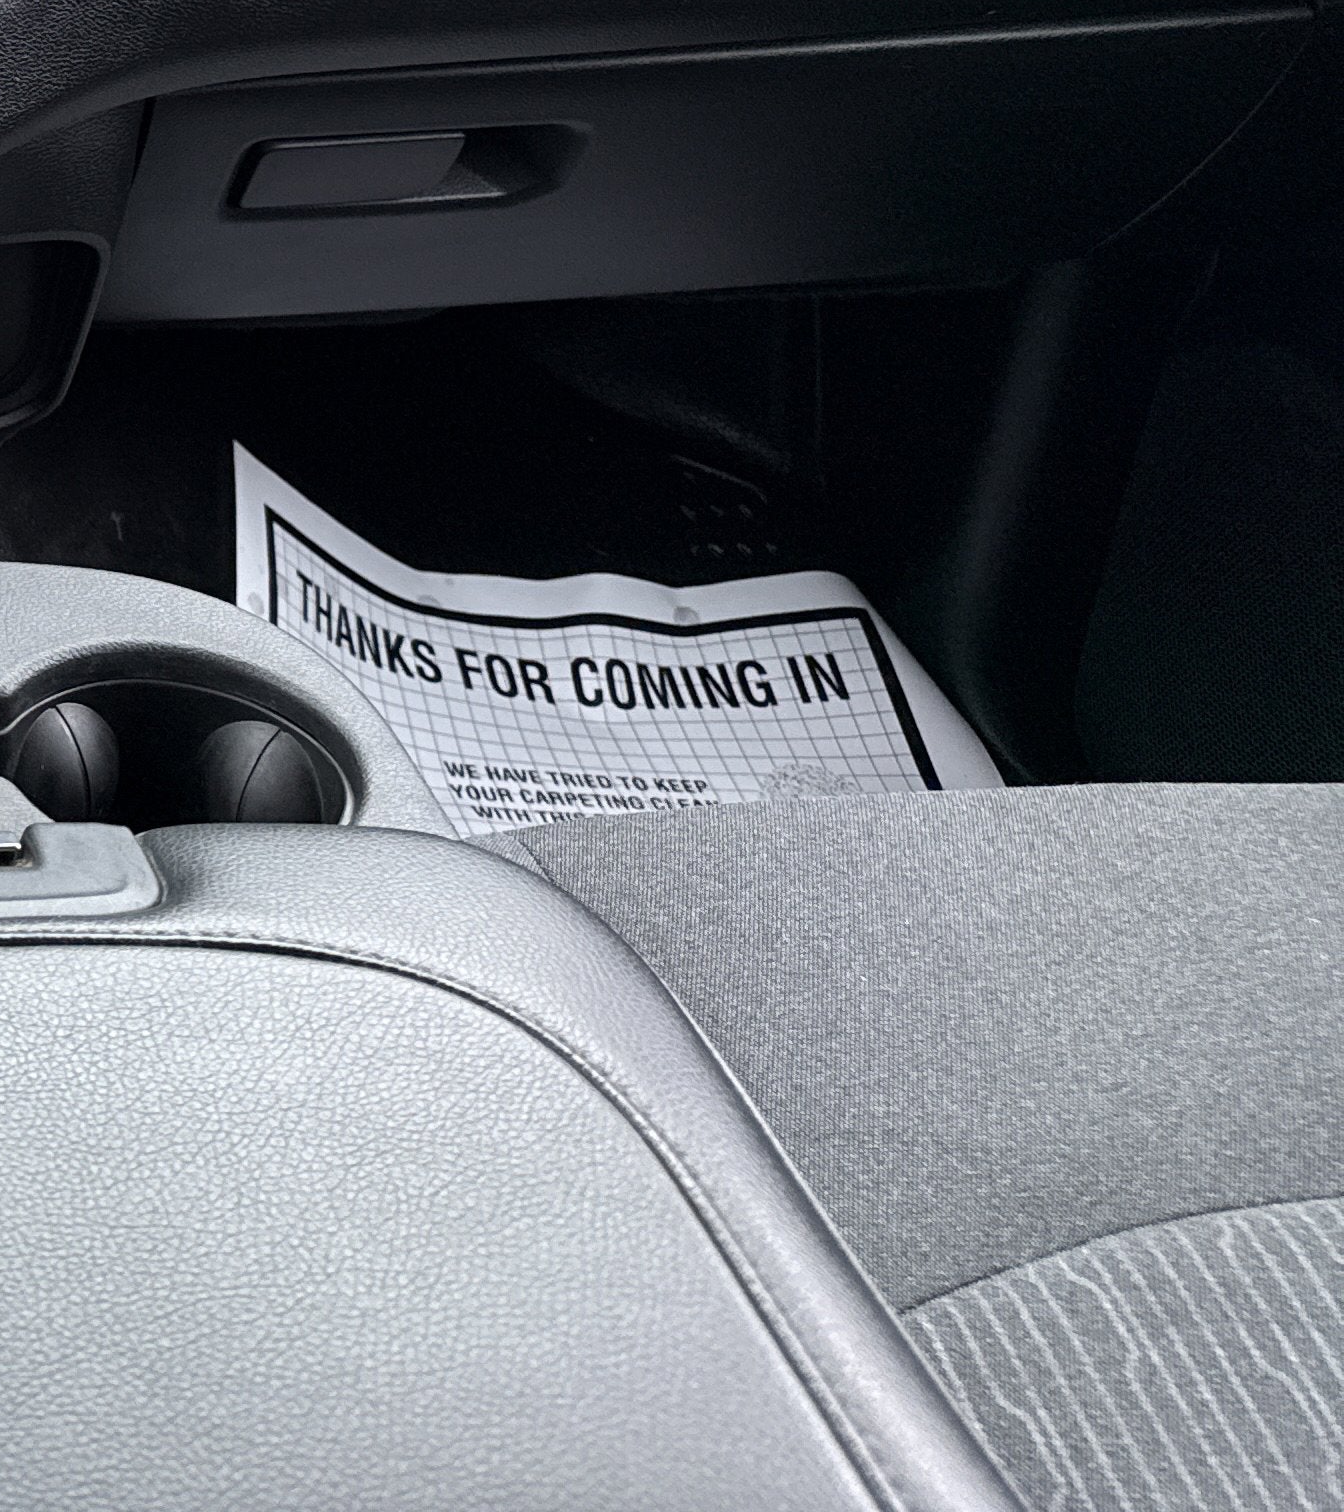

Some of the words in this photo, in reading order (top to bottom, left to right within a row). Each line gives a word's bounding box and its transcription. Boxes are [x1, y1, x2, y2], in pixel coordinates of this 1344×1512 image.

[295, 570, 443, 685] THANKS
[457, 646, 557, 705] FOR
[572, 655, 779, 710] COMING
[785, 653, 851, 704] IN
[443, 760, 481, 780] WE
[484, 765, 540, 785] HAVE
[546, 771, 614, 790] TRIED
[617, 775, 648, 792] TO
[653, 777, 708, 794] KEEP
[448, 784, 515, 804] YOUR
[520, 788, 645, 810] CARPETING
[470, 805, 531, 824] WITH
